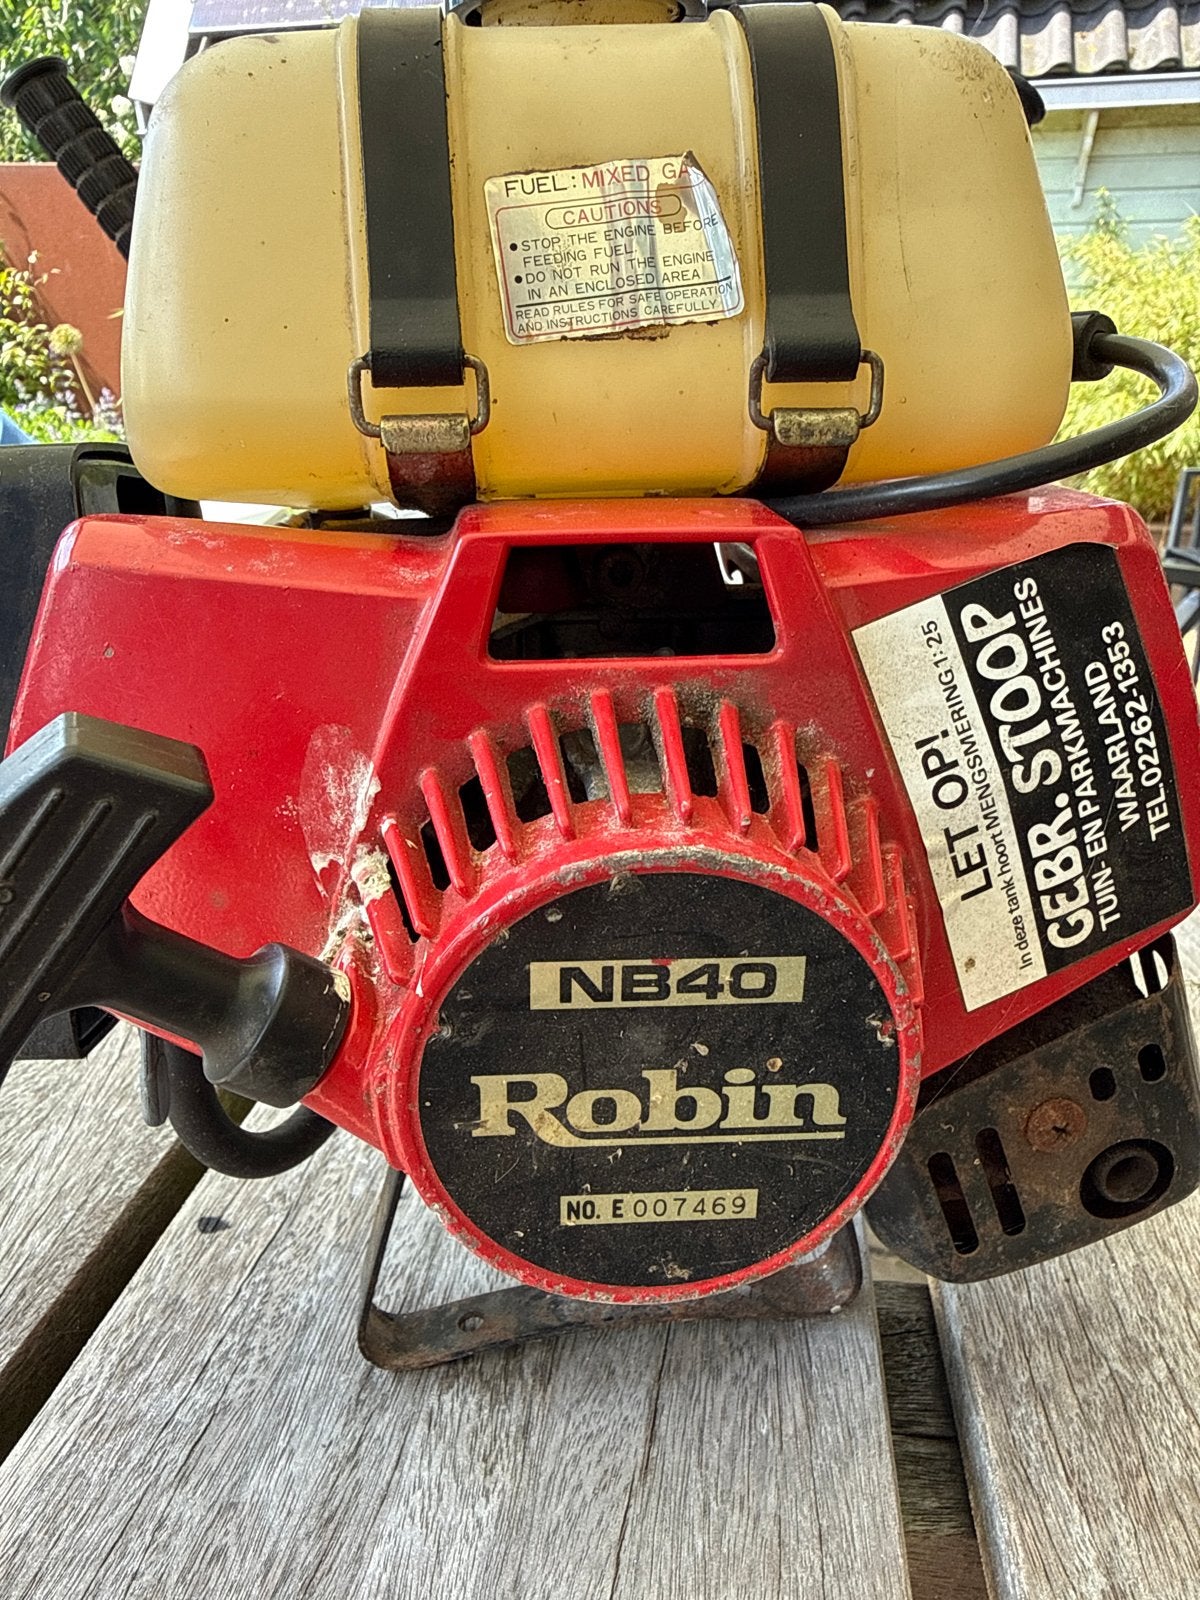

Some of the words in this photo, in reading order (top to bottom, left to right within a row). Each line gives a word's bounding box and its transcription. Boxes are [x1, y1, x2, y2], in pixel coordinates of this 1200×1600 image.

[505, 175, 577, 198] FUEL:
[581, 165, 650, 189] MIXED
[521, 236, 561, 252] STOP
[568, 232, 598, 246] THE
[604, 224, 656, 242] ENGINE
[663, 213, 719, 235] BEFORE
[563, 200, 662, 226] CAUTIONS
[523, 250, 587, 268] FEEDING
[594, 243, 638, 259] FUEL.
[525, 271, 546, 284] DO
[553, 266, 582, 280] NOT
[590, 262, 620, 276] RUN
[627, 256, 656, 270] THE
[663, 250, 715, 267] ENGINE
[516, 307, 550, 320] READ
[553, 300, 595, 315] RULES
[599, 296, 624, 309] FOR
[629, 291, 660, 304] SAFE
[665, 281, 733, 301] OPERATION
[528, 288, 542, 300] IN
[549, 284, 568, 297] AN
[575, 273, 655, 294] ENCLOSED
[662, 268, 701, 284] AREA
[517, 321, 543, 334] AND
[547, 307, 638, 330] INSTRUCTIONS
[644, 299, 717, 315] CAREFULLY
[960, 603, 1062, 794] STOOP
[1013, 577, 1100, 818] PARKMACHINES
[938, 668, 1000, 831] MENGSMERING
[1084, 661, 1141, 832] WAARLAND
[914, 728, 969, 810] OP!
[990, 830, 1011, 878] hoort
[1082, 818, 1108, 859] EN
[943, 825, 993, 902] LET
[1027, 792, 1094, 949] GEBR.
[1000, 876, 1020, 914] tank
[1091, 860, 1121, 932] TUIN-
[1012, 915, 1030, 958] deze
[1019, 952, 1033, 970] In
[559, 961, 777, 1004] NB40
[471, 1068, 847, 1147] Robin
[566, 1200, 601, 1220] NO.
